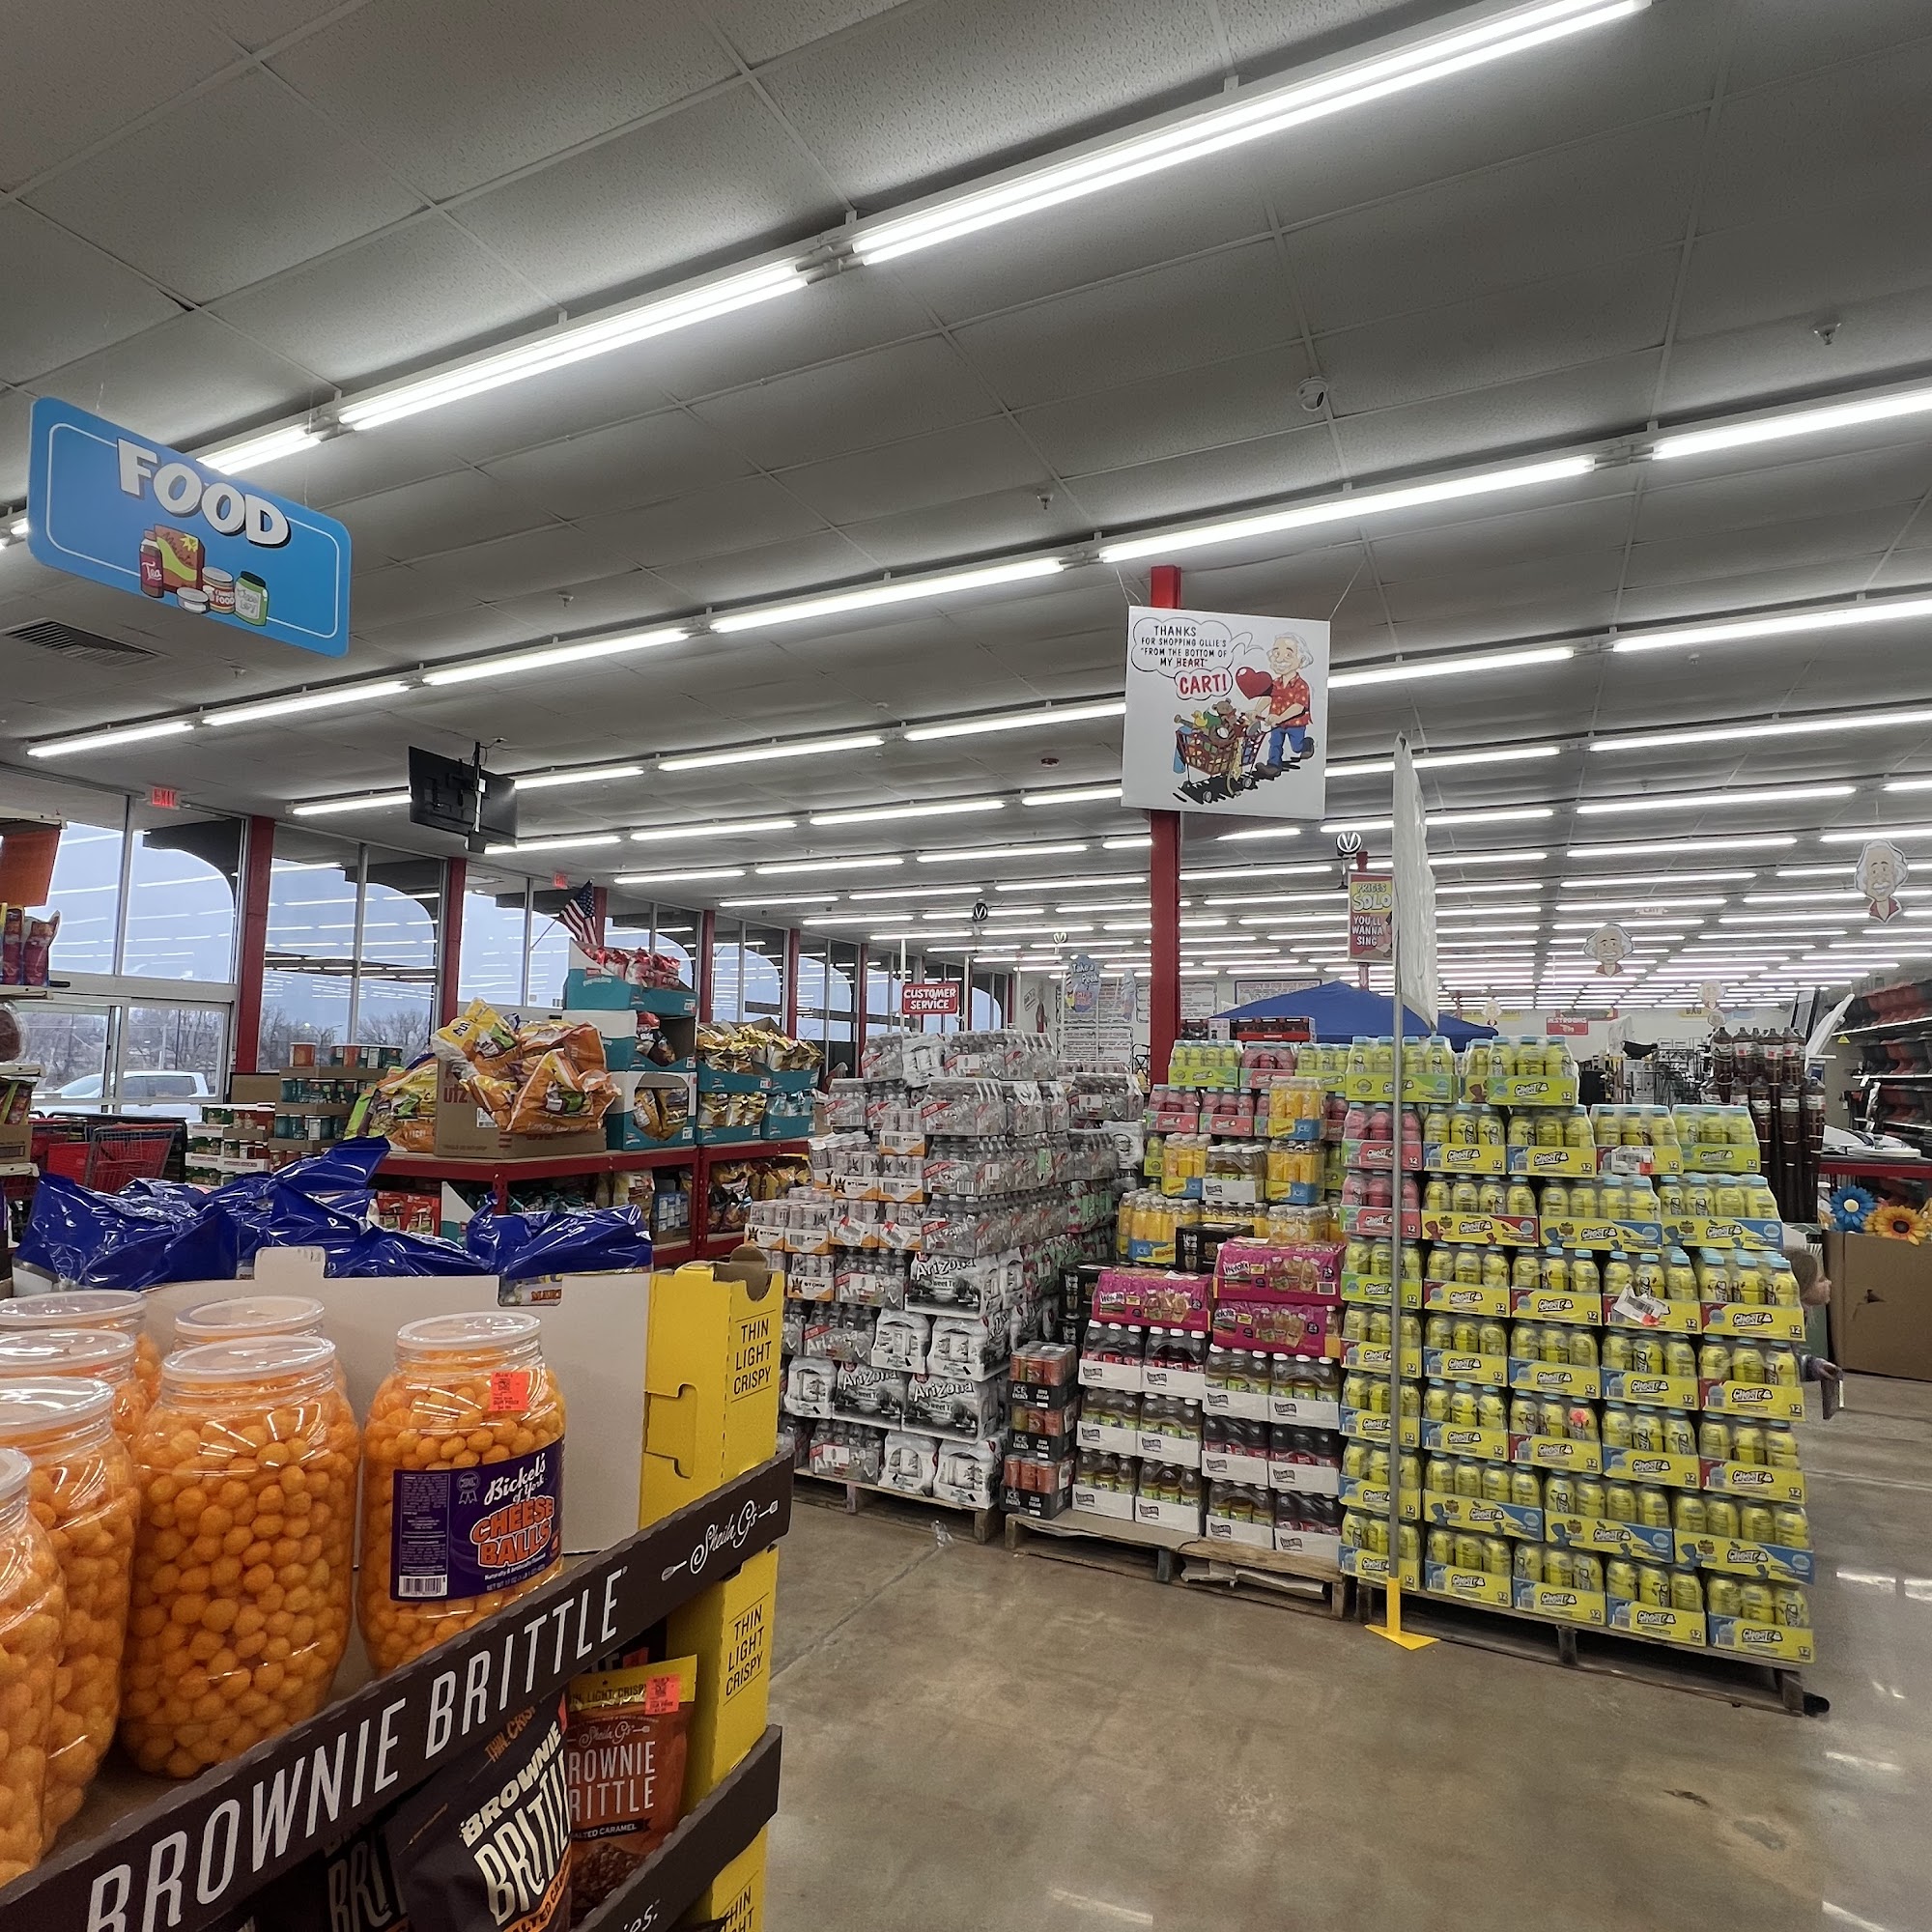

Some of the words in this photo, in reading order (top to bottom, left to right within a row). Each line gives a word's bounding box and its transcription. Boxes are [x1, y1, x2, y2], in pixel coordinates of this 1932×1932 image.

[117, 438, 291, 548] FOOD
[142, 560, 162, 581] Tea
[1154, 625, 1197, 637] THANKS
[1160, 658, 1173, 667] MY
[1179, 673, 1228, 695] CART!
[155, 787, 176, 807] EXIT
[1357, 883, 1387, 894] PRICES
[1353, 915, 1381, 926] YOU'LL
[1351, 925, 1383, 935] WANNA
[1356, 935, 1378, 947] SING
[1082, 974, 1098, 984] Peek
[904, 987, 956, 999] CUSTOMER
[910, 999, 950, 1010] SERVICE
[1515, 1083, 1539, 1095] GHOST
[1448, 1151, 1470, 1162] GHOST
[1534, 1153, 1559, 1165] GHOST
[1581, 1228, 1608, 1240] GHOST
[1706, 1226, 1733, 1239] GHOST
[1538, 1299, 1565, 1312] GHOST
[1587, 1311, 1598, 1320] 12
[1733, 1313, 1760, 1326] GHOST
[1686, 1319, 1696, 1327] 12
[1789, 1325, 1801, 1334] 12
[741, 1318, 769, 1345] THIN
[735, 1341, 772, 1372] LIGHT
[1406, 1363, 1416, 1372] 12
[733, 1366, 772, 1395] CRISPY
[1537, 1372, 1564, 1384] GHOST
[1585, 1384, 1596, 1393] 12
[1631, 1380, 1661, 1393] GHOST
[1683, 1395, 1693, 1404] 12
[1732, 1388, 1763, 1402] GHOST
[1790, 1405, 1802, 1413] 12
[1406, 1433, 1414, 1441] 12
[1493, 1446, 1503, 1455] 12
[1538, 1443, 1565, 1457] GHOST
[1587, 1459, 1597, 1467] 12
[1633, 1460, 1662, 1473] GHOST
[484, 1453, 546, 1506] Bickel's
[1685, 1473, 1695, 1482] 12
[1732, 1470, 1764, 1485] GHOST
[513, 1489, 523, 1505] of
[524, 1475, 546, 1498] York
[1789, 1488, 1802, 1497] 12
[1406, 1505, 1415, 1514] 12
[470, 1496, 554, 1544] CHEESE
[1594, 1529, 1622, 1542] GHOST
[478, 1520, 553, 1568] BALLS
[690, 1513, 736, 1575] Sheila
[1727, 1549, 1760, 1563] GHOST
[1405, 1576, 1414, 1584] 12
[1498, 1592, 1508, 1601] 12
[1590, 1610, 1601, 1619] 12
[1637, 1611, 1666, 1625] GHOST
[734, 1604, 763, 1641] THIN
[1690, 1630, 1701, 1639] 12
[1742, 1629, 1774, 1642] GHOST
[727, 1626, 765, 1672] LIGHT
[1799, 1646, 1810, 1656] 12
[725, 1650, 763, 1696] CRISPY
[85, 1697, 407, 1932] BROWNIE
[425, 1567, 623, 1760] BRITTLE
[568, 1740, 657, 1786] ROWNIE
[459, 1720, 562, 1848] BROWNIE
[568, 1775, 657, 1823] RITTLE
[473, 1748, 572, 1927] BRITTL
[570, 1829, 599, 1841] ALTED
[599, 1823, 638, 1836] CARAMEL
[513, 1901, 552, 1932] LTED
